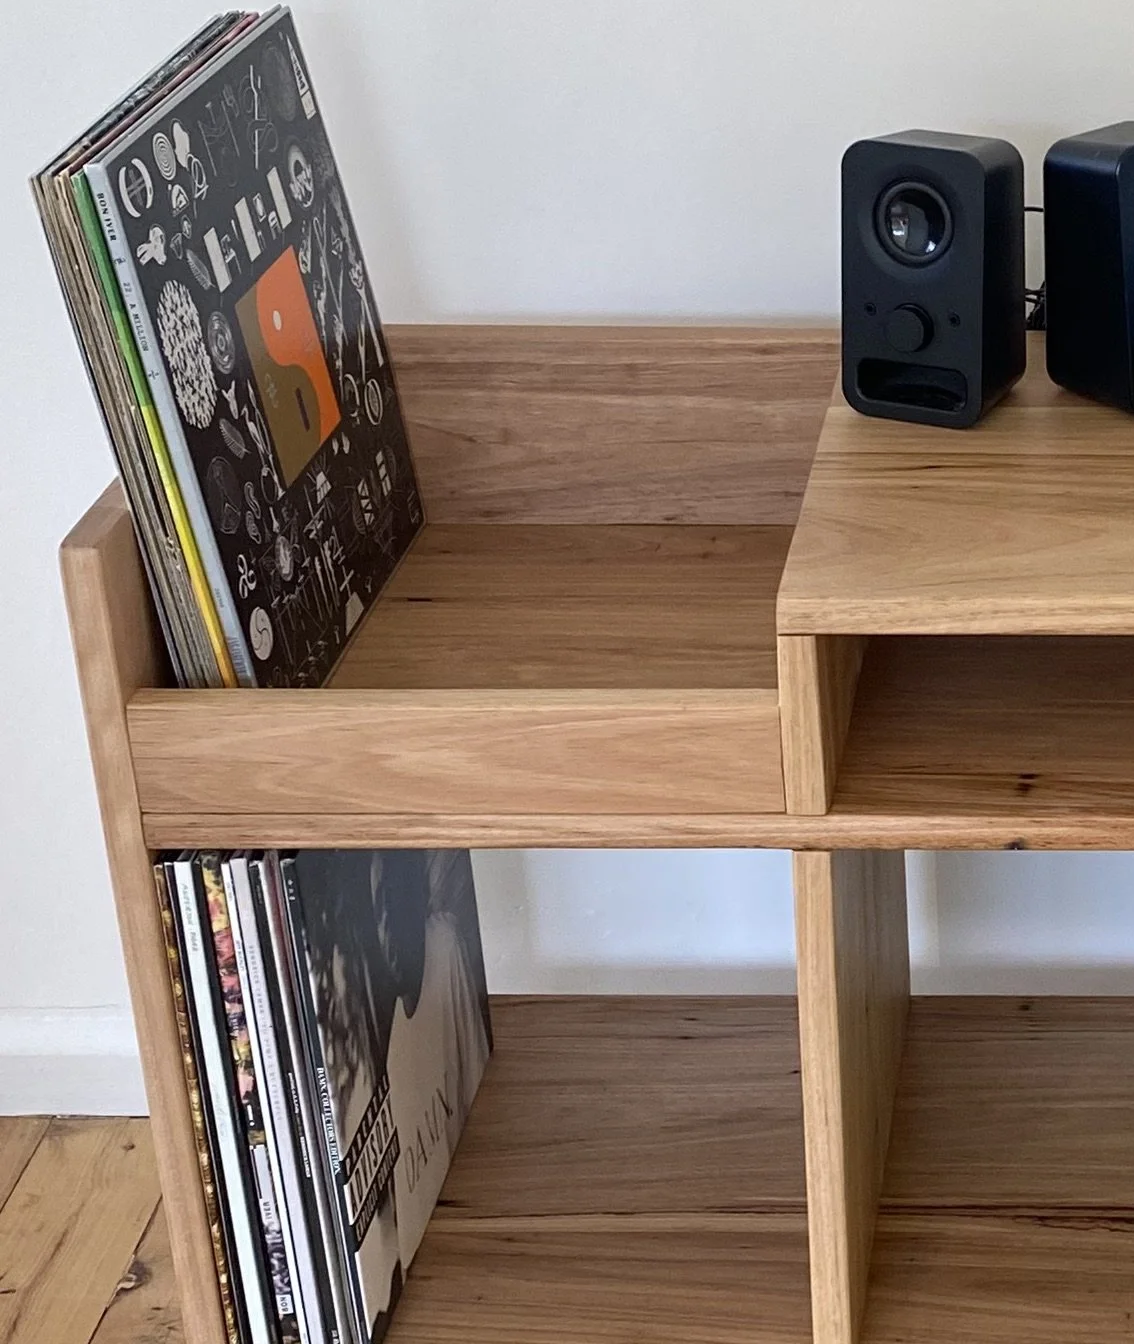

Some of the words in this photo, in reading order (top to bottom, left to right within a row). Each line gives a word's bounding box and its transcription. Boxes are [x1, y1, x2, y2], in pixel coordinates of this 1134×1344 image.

[97, 192, 109, 215] BON
[104, 217, 117, 242] IVER
[132, 313, 150, 352] MILLION
[321, 1092, 336, 1143] COLLECTORS
[329, 1143, 341, 1175] EDITION
[345, 1073, 389, 1177] PARENTAL
[350, 1094, 394, 1220] ADVISORY
[279, 1296, 289, 1313] BON
